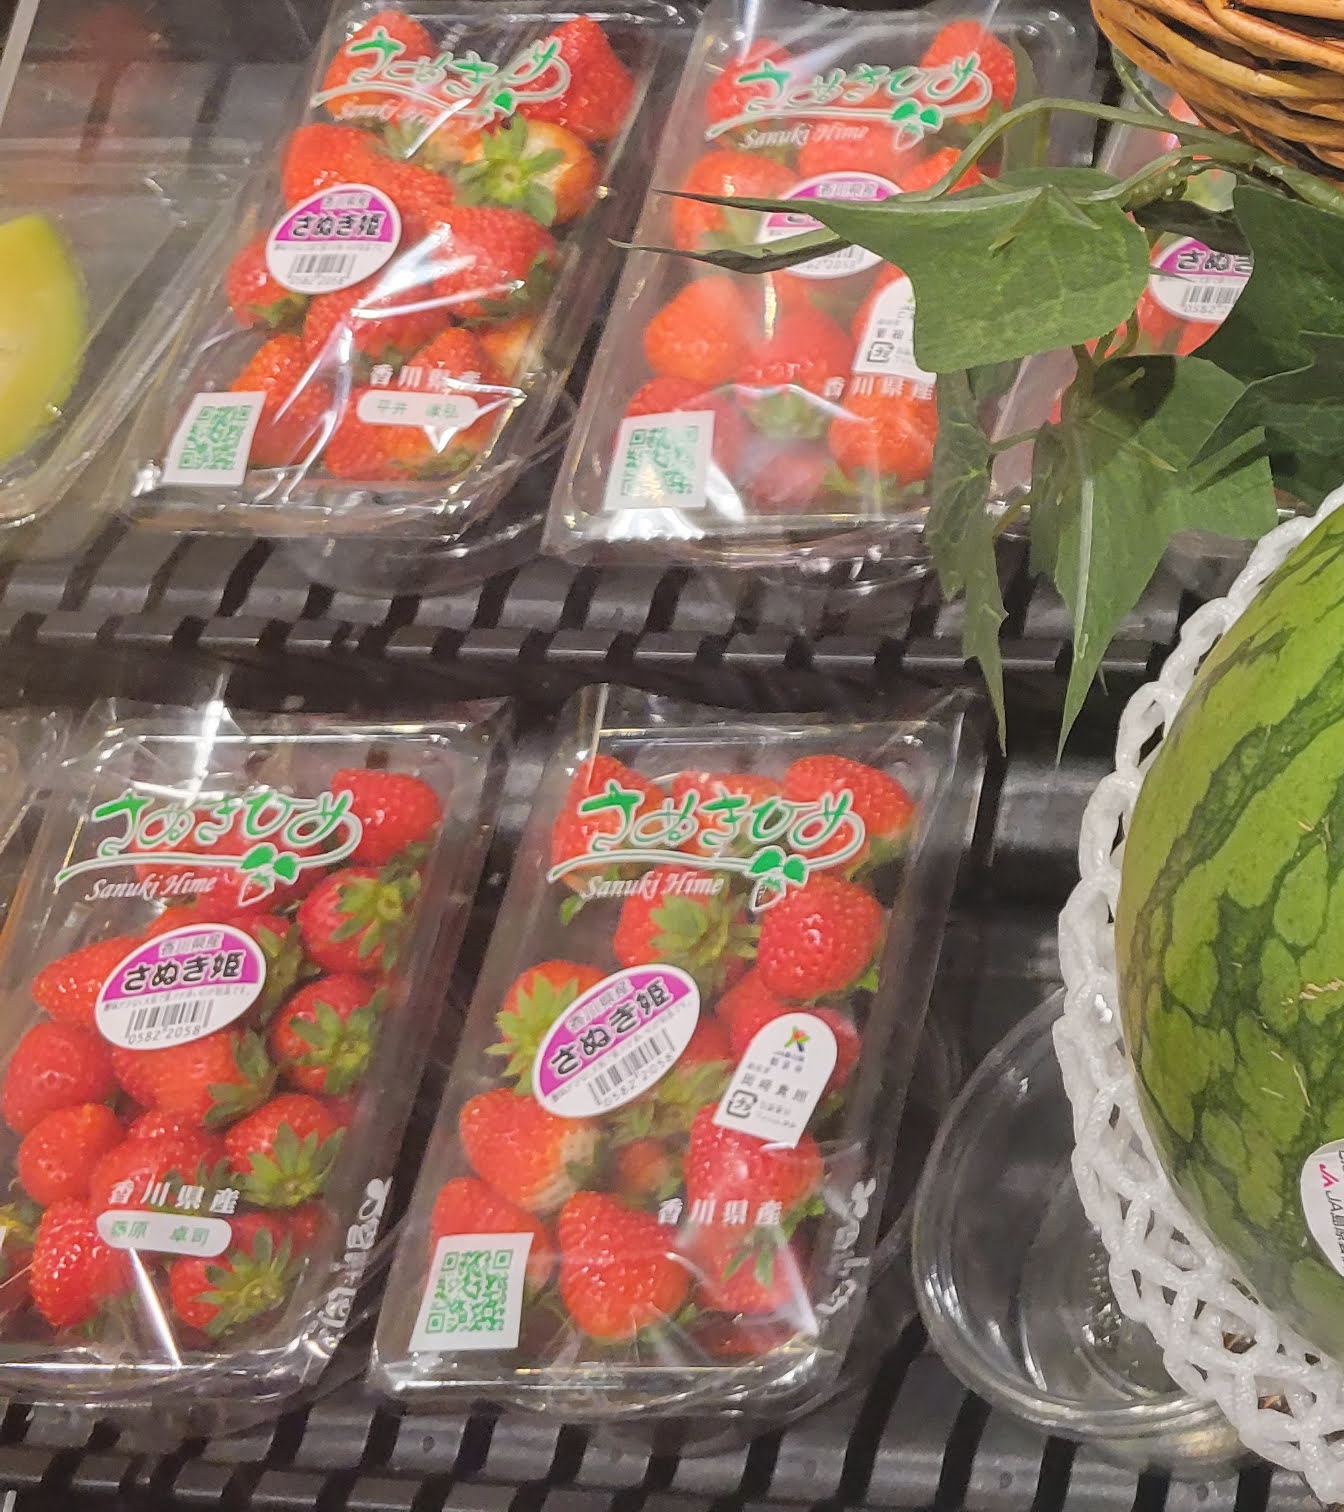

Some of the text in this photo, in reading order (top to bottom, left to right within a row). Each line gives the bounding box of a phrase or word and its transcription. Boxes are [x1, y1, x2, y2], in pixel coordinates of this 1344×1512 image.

[578, 779, 865, 856] さぬきひめ
[84, 873, 157, 901] Sanuki
[580, 871, 659, 901] Sanuki
[124, 951, 244, 991] さぬき姫
[108, 1176, 240, 1215] 香川県産
[658, 1197, 783, 1226] 香川県産
